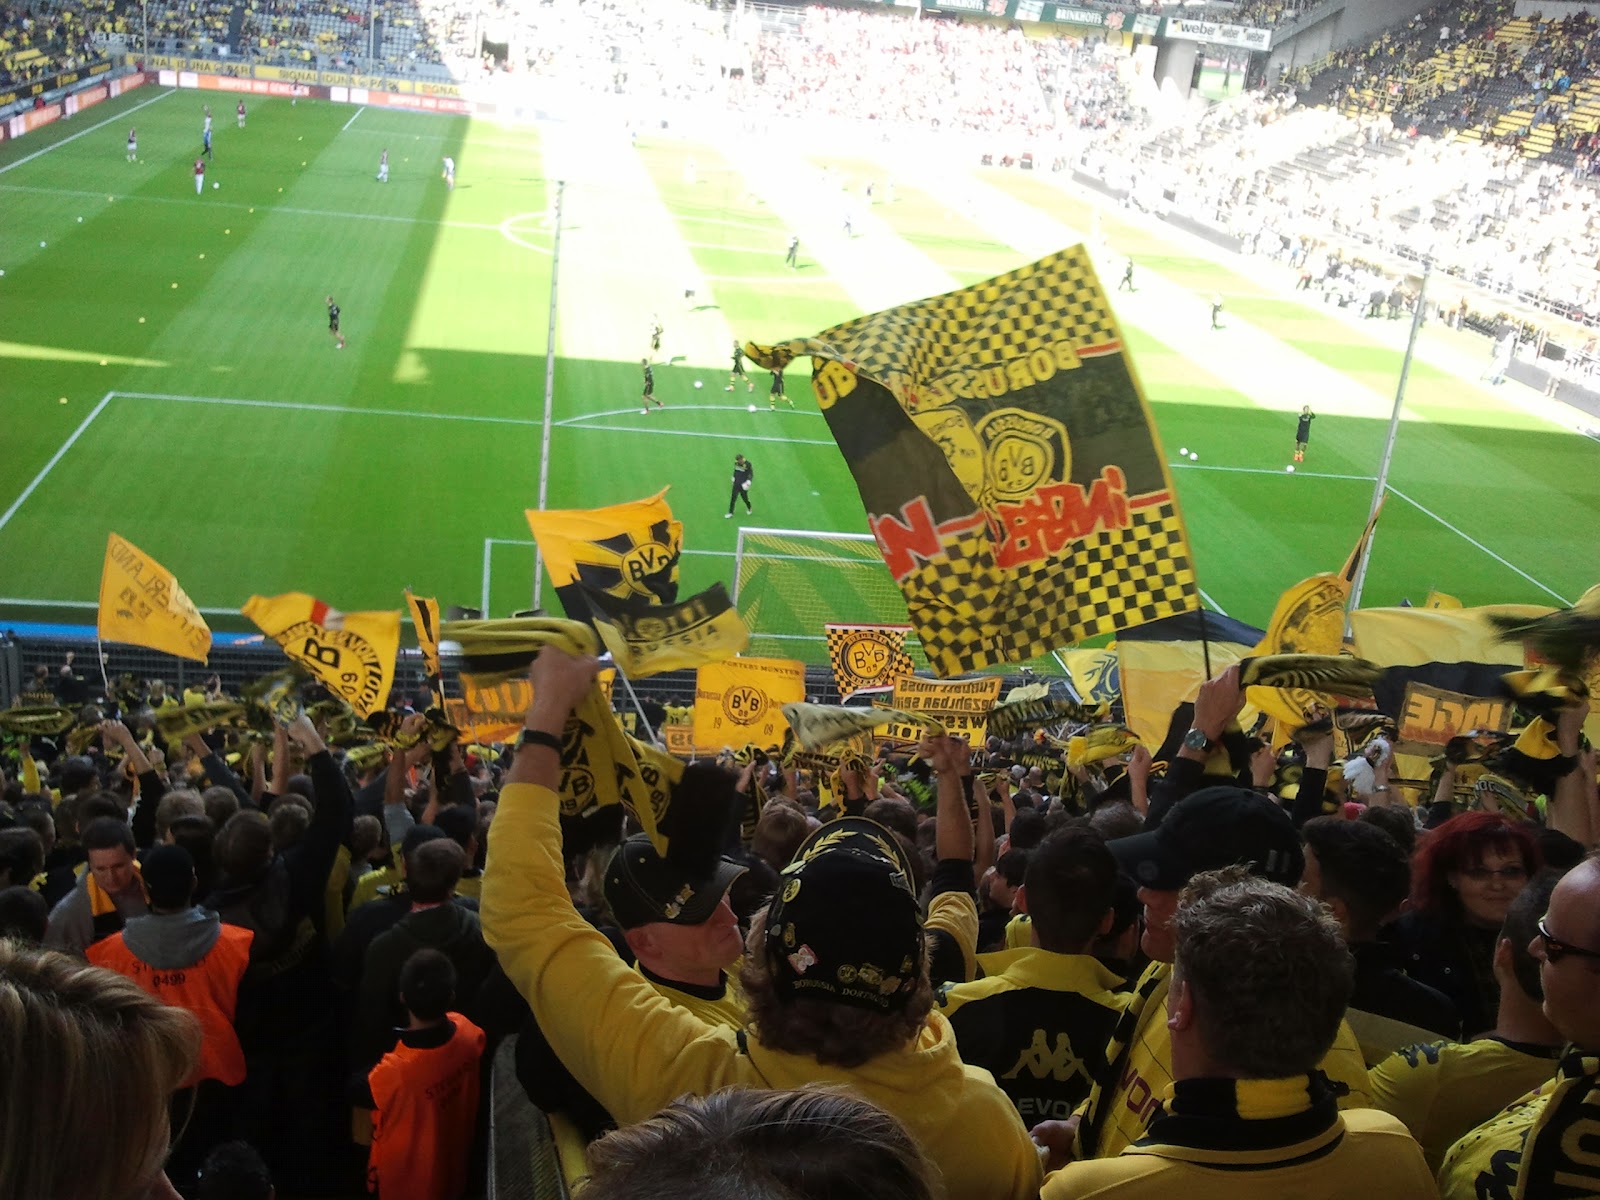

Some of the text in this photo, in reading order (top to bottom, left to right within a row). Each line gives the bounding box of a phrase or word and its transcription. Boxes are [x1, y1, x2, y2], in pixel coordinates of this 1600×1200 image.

[1181, 20, 1215, 35] weber
[1247, 30, 1265, 43] weber
[279, 69, 318, 83] SIGNAL
[732, 689, 760, 712] BVB
[792, 980, 837, 993] BORUSSIA
[1018, 1097, 1071, 1120] EVO
